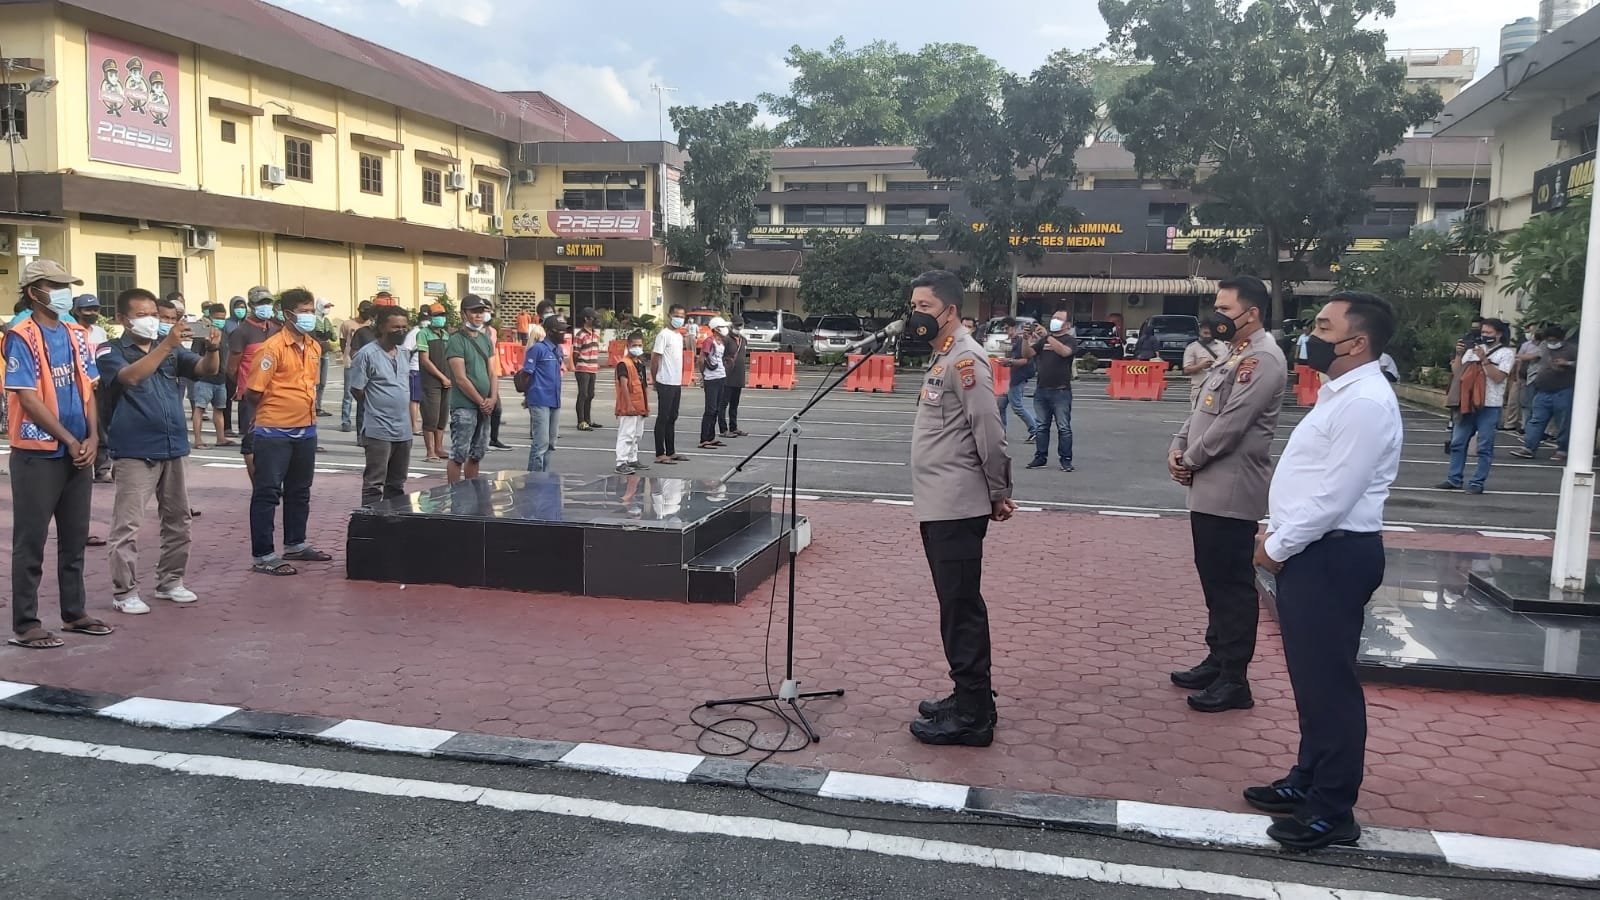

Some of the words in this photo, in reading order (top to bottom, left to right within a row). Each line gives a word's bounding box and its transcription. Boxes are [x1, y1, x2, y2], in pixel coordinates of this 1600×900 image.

[97, 121, 173, 148] PRESISI
[556, 215, 640, 229] PRESISI
[750, 226, 767, 234] OAD
[768, 226, 785, 234] MAP
[1066, 236, 1105, 247] MEDAN
[566, 244, 580, 256] SAT
[581, 244, 603, 257] TAHTI
